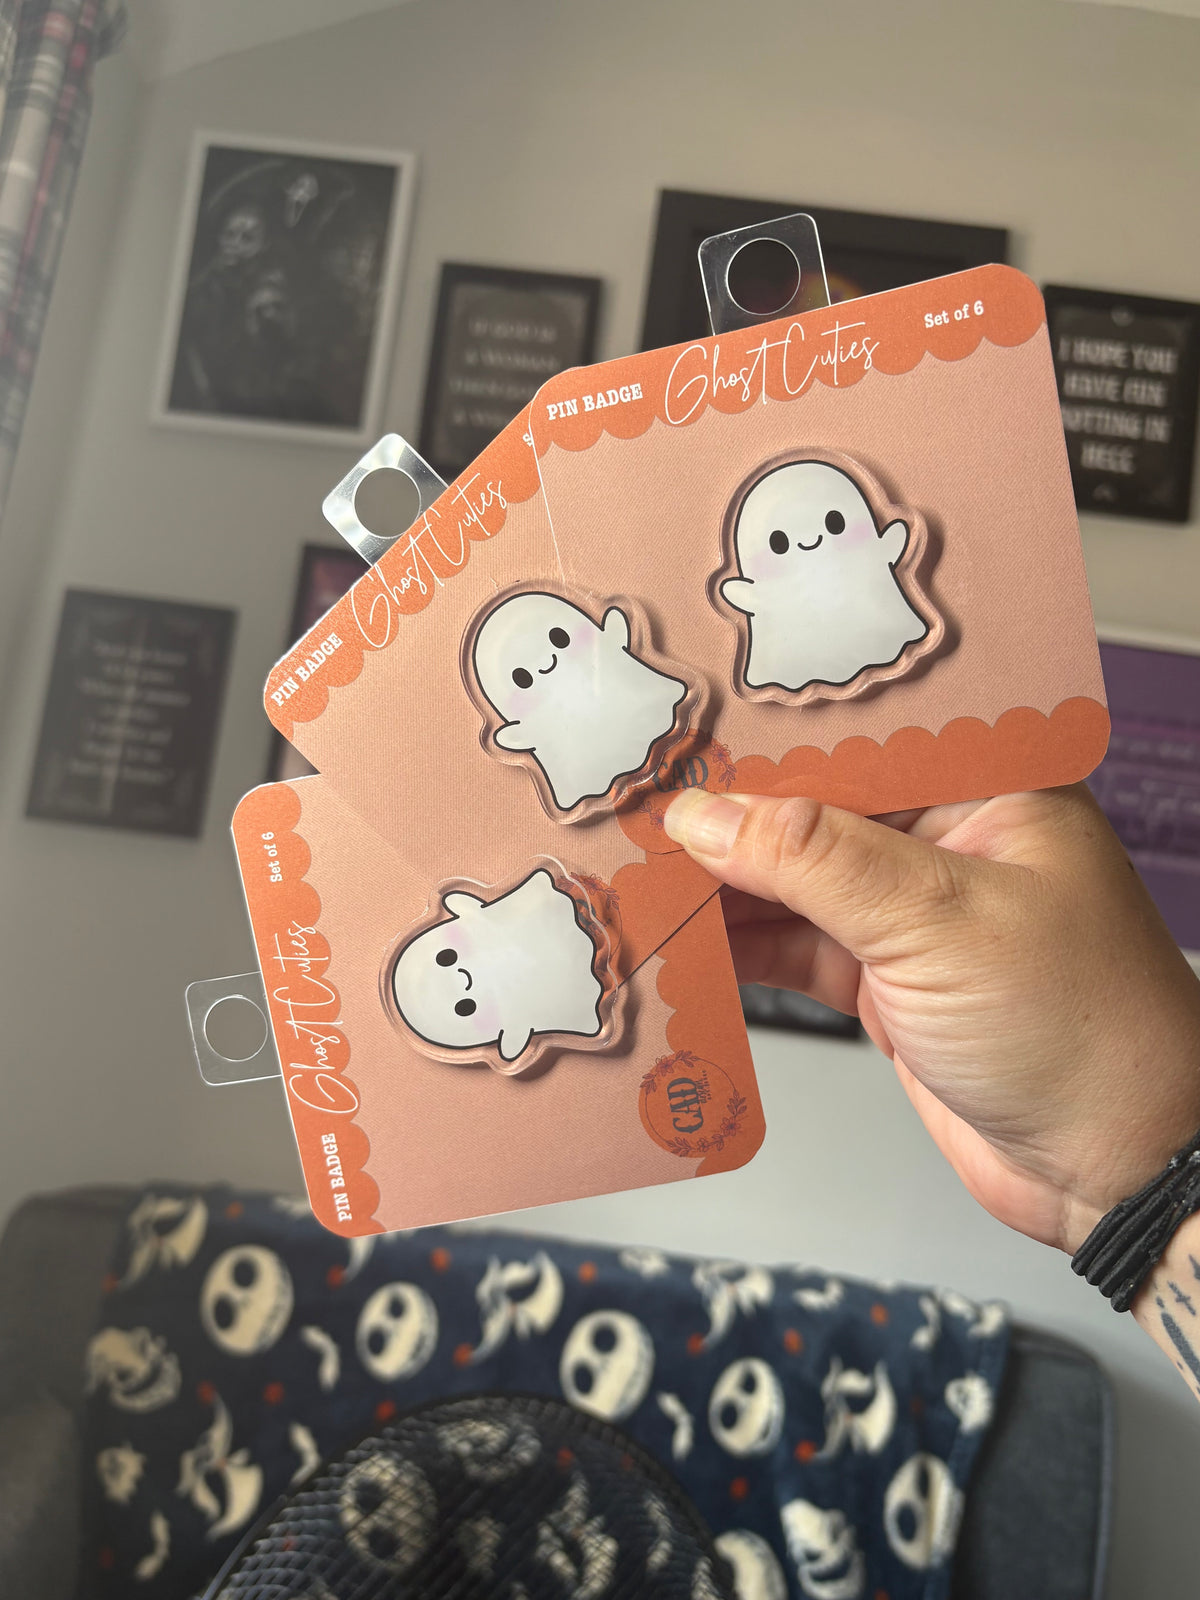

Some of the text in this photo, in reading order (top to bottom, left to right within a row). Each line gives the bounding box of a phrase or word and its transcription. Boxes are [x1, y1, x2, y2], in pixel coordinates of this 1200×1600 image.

[924, 300, 985, 329] Set of 6
[546, 383, 643, 421] PIN BADGE
[665, 320, 880, 425] Ghost Cuties
[350, 472, 508, 648] Ghost Cuties
[270, 632, 344, 707] PIN BADGE
[261, 831, 283, 883] Set of 6
[272, 920, 359, 1114] Ghost Cuties
[666, 1077, 704, 1134] CAD
[321, 1132, 353, 1222] PIN BADGE
